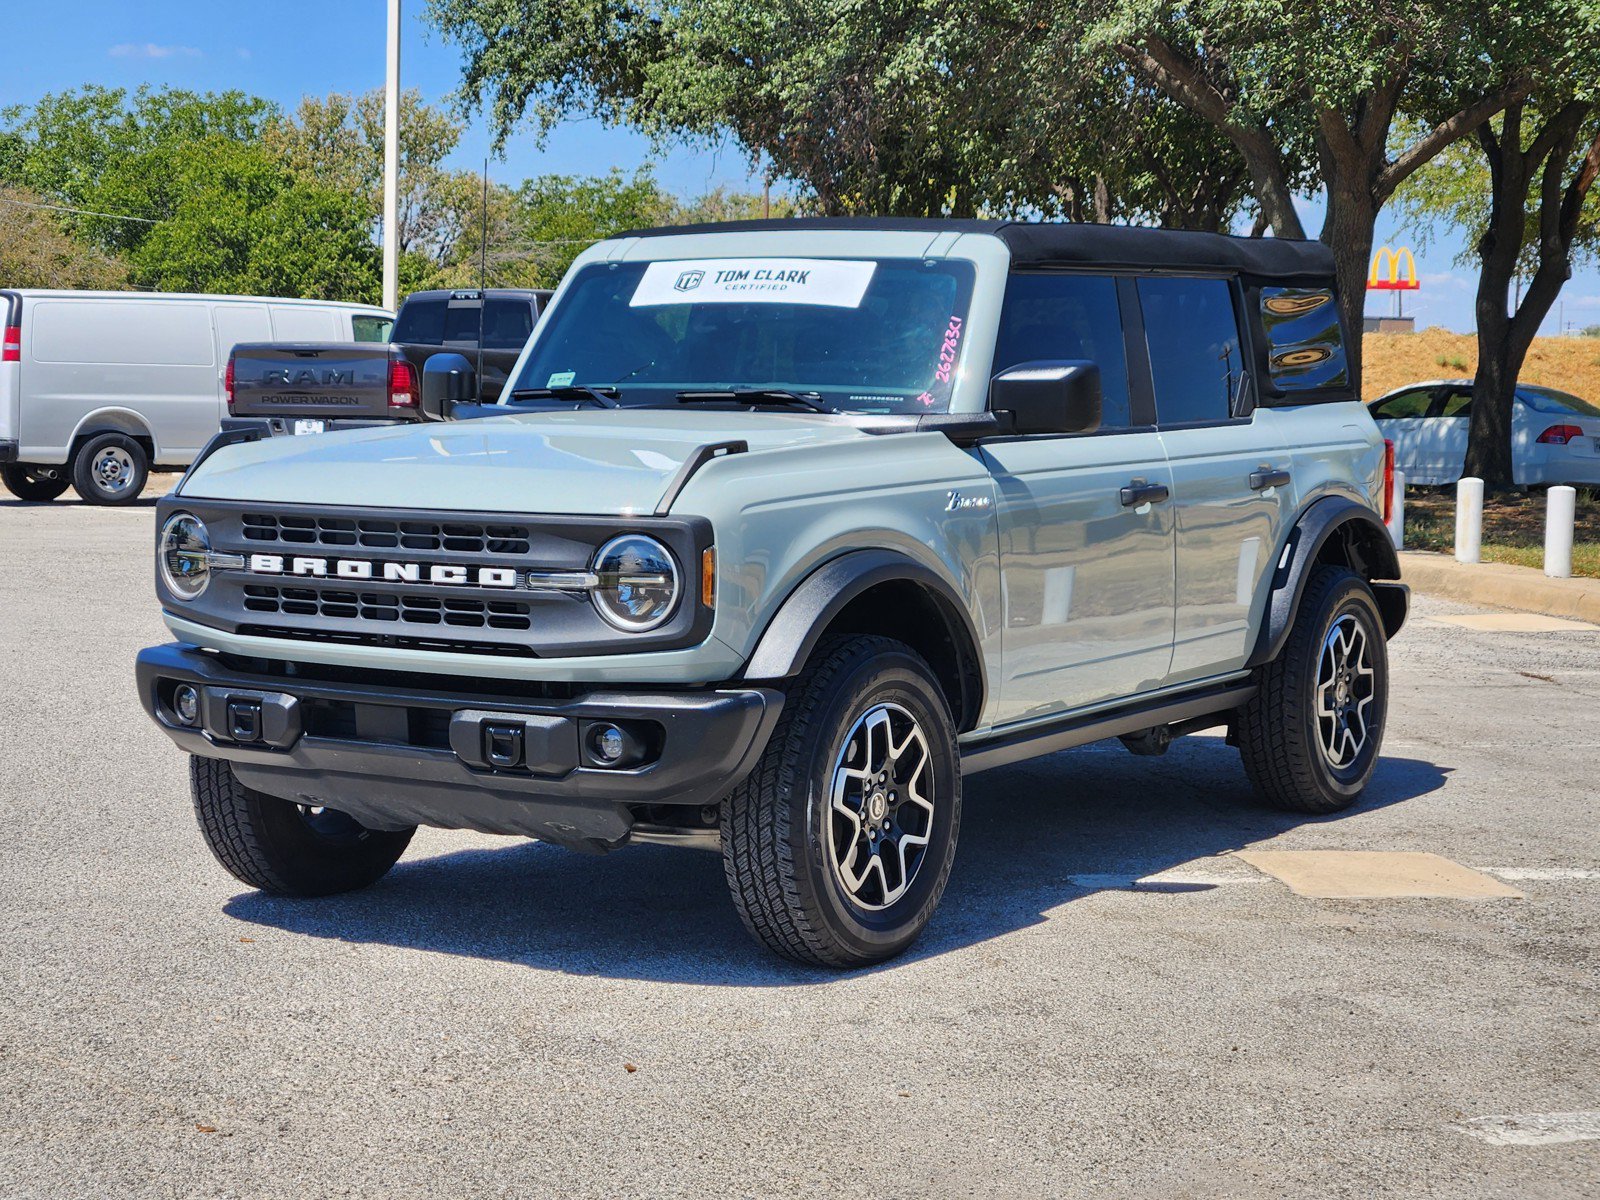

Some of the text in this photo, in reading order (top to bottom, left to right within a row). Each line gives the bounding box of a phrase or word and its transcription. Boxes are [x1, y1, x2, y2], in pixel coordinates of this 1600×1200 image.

[714, 269, 812, 285] TOM CLARK
[724, 283, 788, 291] CERTIFIED
[263, 369, 354, 385] RAM
[261, 395, 359, 405] POWER WAGON
[250, 554, 517, 587] BRONCO
